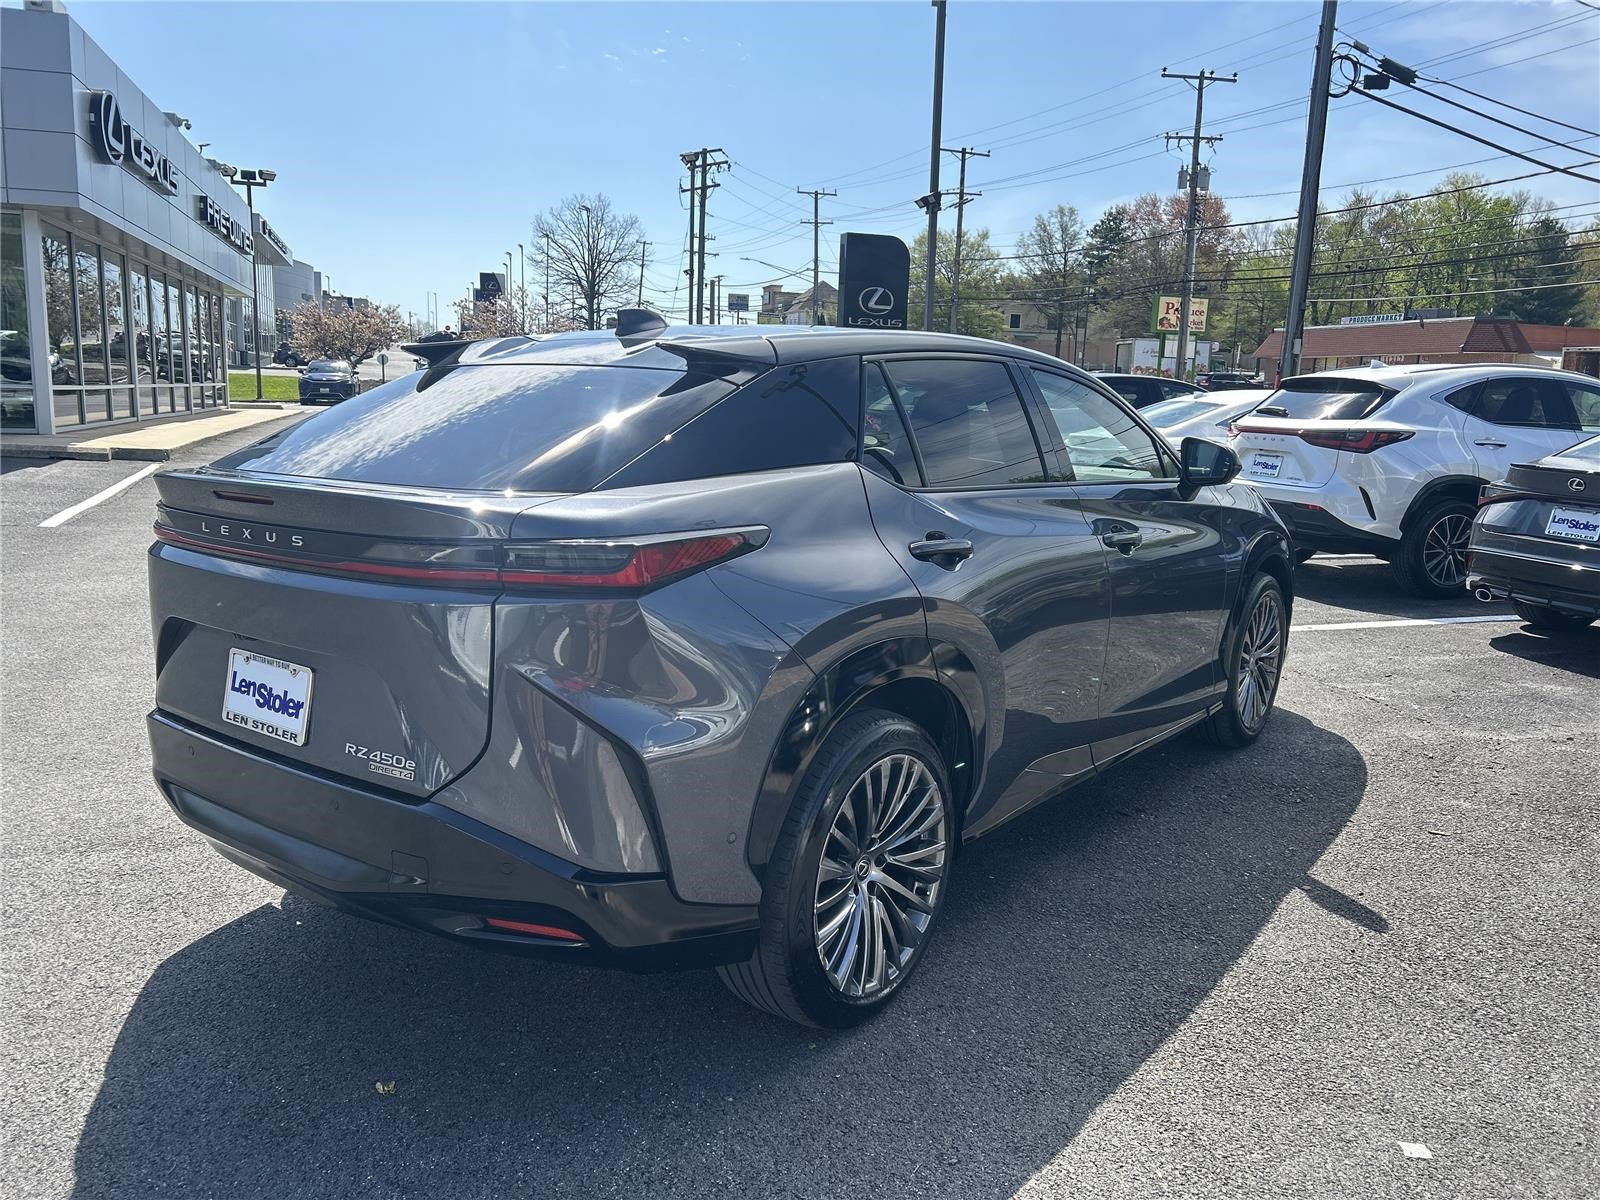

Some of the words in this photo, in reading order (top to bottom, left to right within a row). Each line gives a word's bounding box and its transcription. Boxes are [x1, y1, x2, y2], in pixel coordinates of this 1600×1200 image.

[127, 124, 178, 196] LEXUS
[848, 316, 902, 328] LEXUS
[1349, 316, 1376, 324] PRODUCE
[1376, 313, 1403, 322] MARKET
[202, 522, 303, 546] LEXUS
[1564, 532, 1595, 540] STOLER
[252, 654, 266, 664] BETTER
[226, 711, 248, 726] LEN
[251, 720, 298, 742] STOLER
[369, 763, 414, 780] DIRECT4
